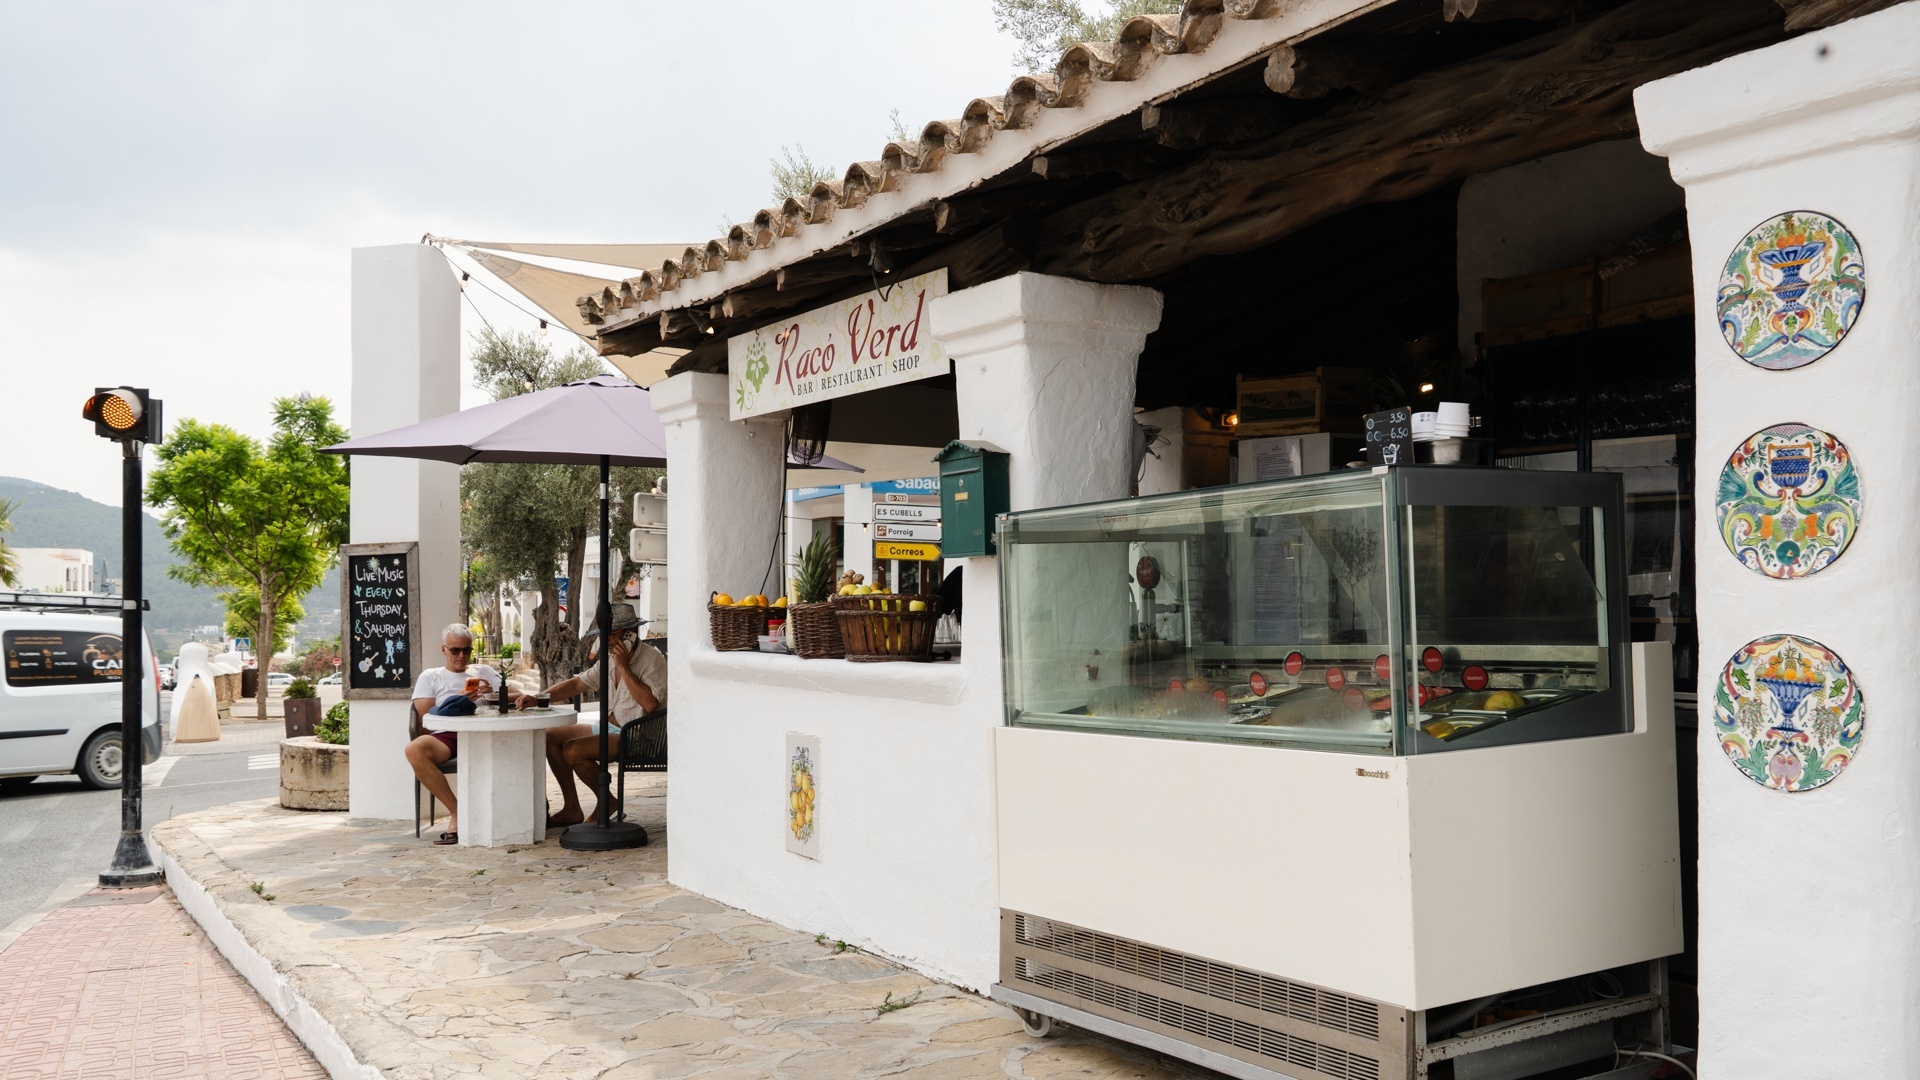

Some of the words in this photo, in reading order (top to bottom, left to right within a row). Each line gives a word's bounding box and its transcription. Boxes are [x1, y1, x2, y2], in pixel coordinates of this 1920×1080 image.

[775, 323, 835, 396] Racó
[847, 288, 926, 365] Verd
[797, 383, 813, 396] BAR
[821, 364, 883, 391] RESTAURANT
[892, 354, 920, 373] SHOP
[877, 508, 887, 516] ES
[889, 509, 923, 517] CUBELLS
[888, 528, 914, 537] Porroig
[889, 546, 924, 556] Correos
[365, 587, 393, 599] EVERY
[355, 600, 402, 618] THURSDAY
[363, 621, 406, 638] SATURDAY
